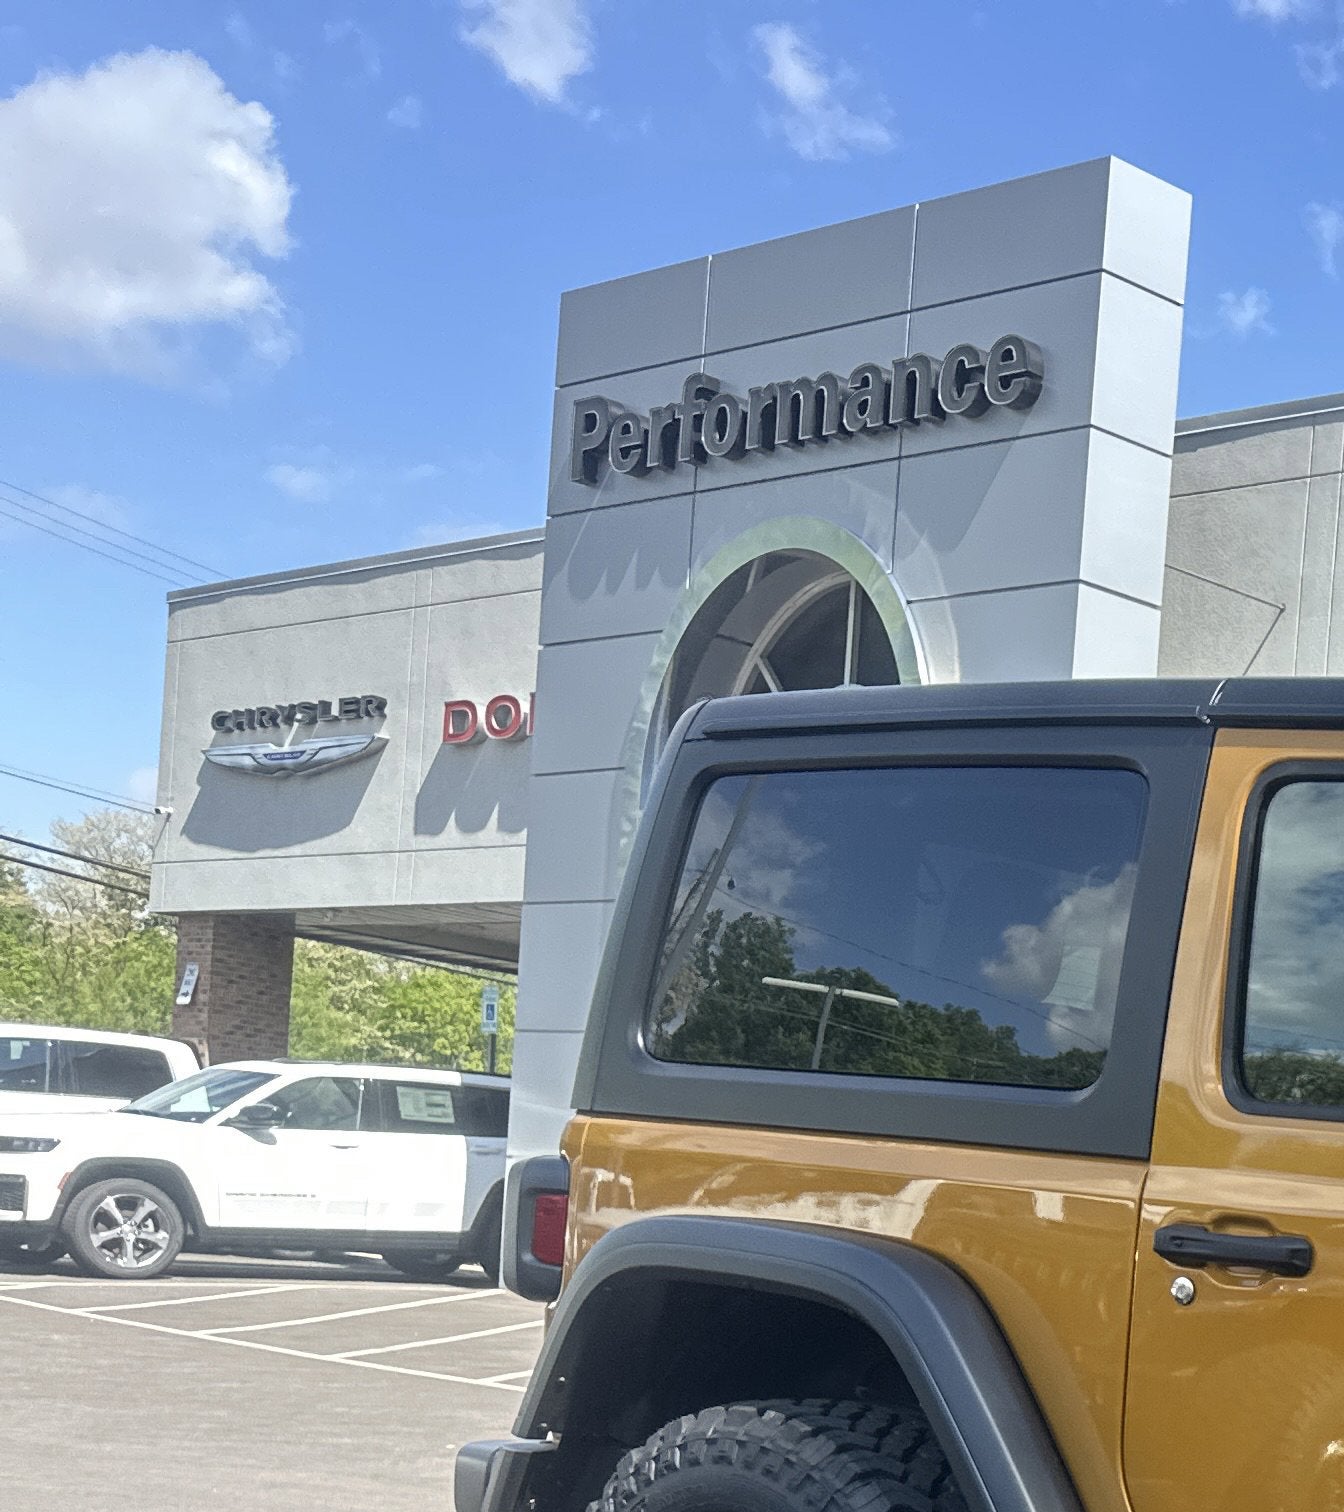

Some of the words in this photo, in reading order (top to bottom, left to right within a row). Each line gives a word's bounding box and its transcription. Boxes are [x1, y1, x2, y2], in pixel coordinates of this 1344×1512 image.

[571, 333, 1044, 485] Performance
[211, 695, 388, 733] CHRYSLER
[443, 691, 536, 745] DO
